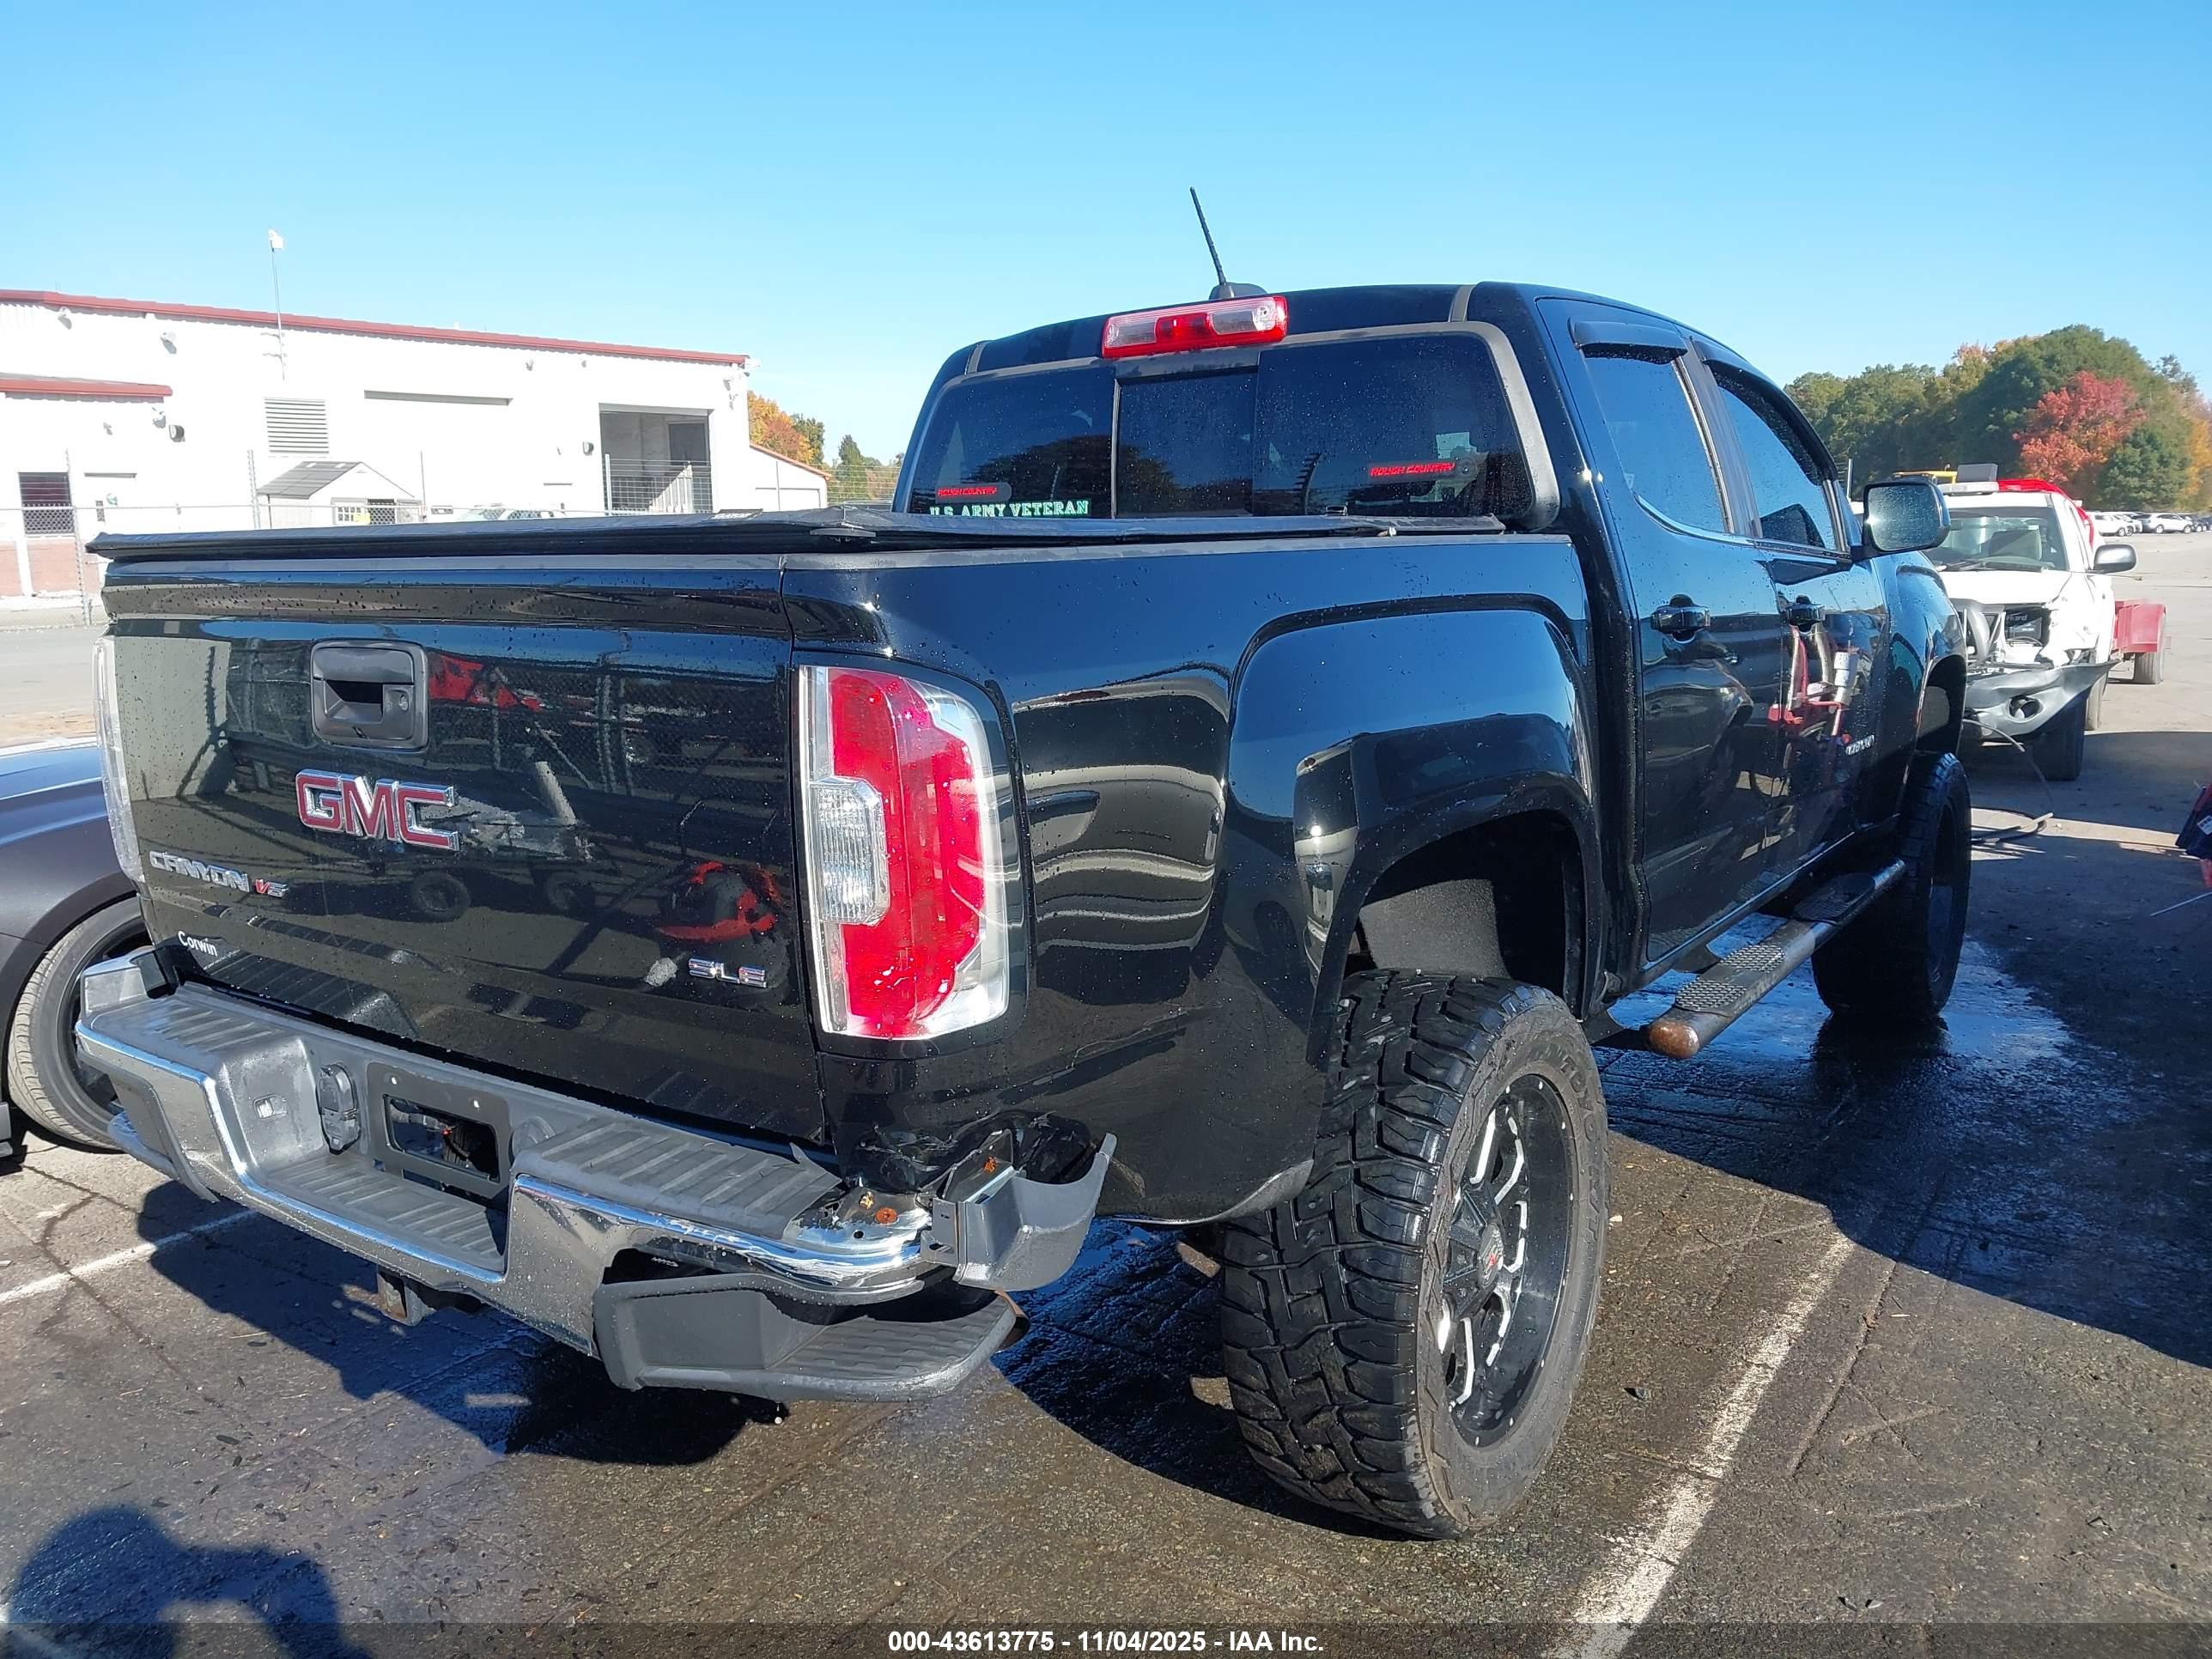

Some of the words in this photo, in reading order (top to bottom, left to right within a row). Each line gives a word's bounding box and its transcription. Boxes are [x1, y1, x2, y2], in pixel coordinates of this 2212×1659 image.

[961, 504, 1006, 517] ARMY
[1009, 500, 1089, 517] VETERAN
[295, 769, 460, 852] GMC
[149, 850, 251, 893] CANYON
[255, 878, 289, 898] V6
[178, 930, 218, 957] Corwin
[689, 957, 767, 988] SLE
